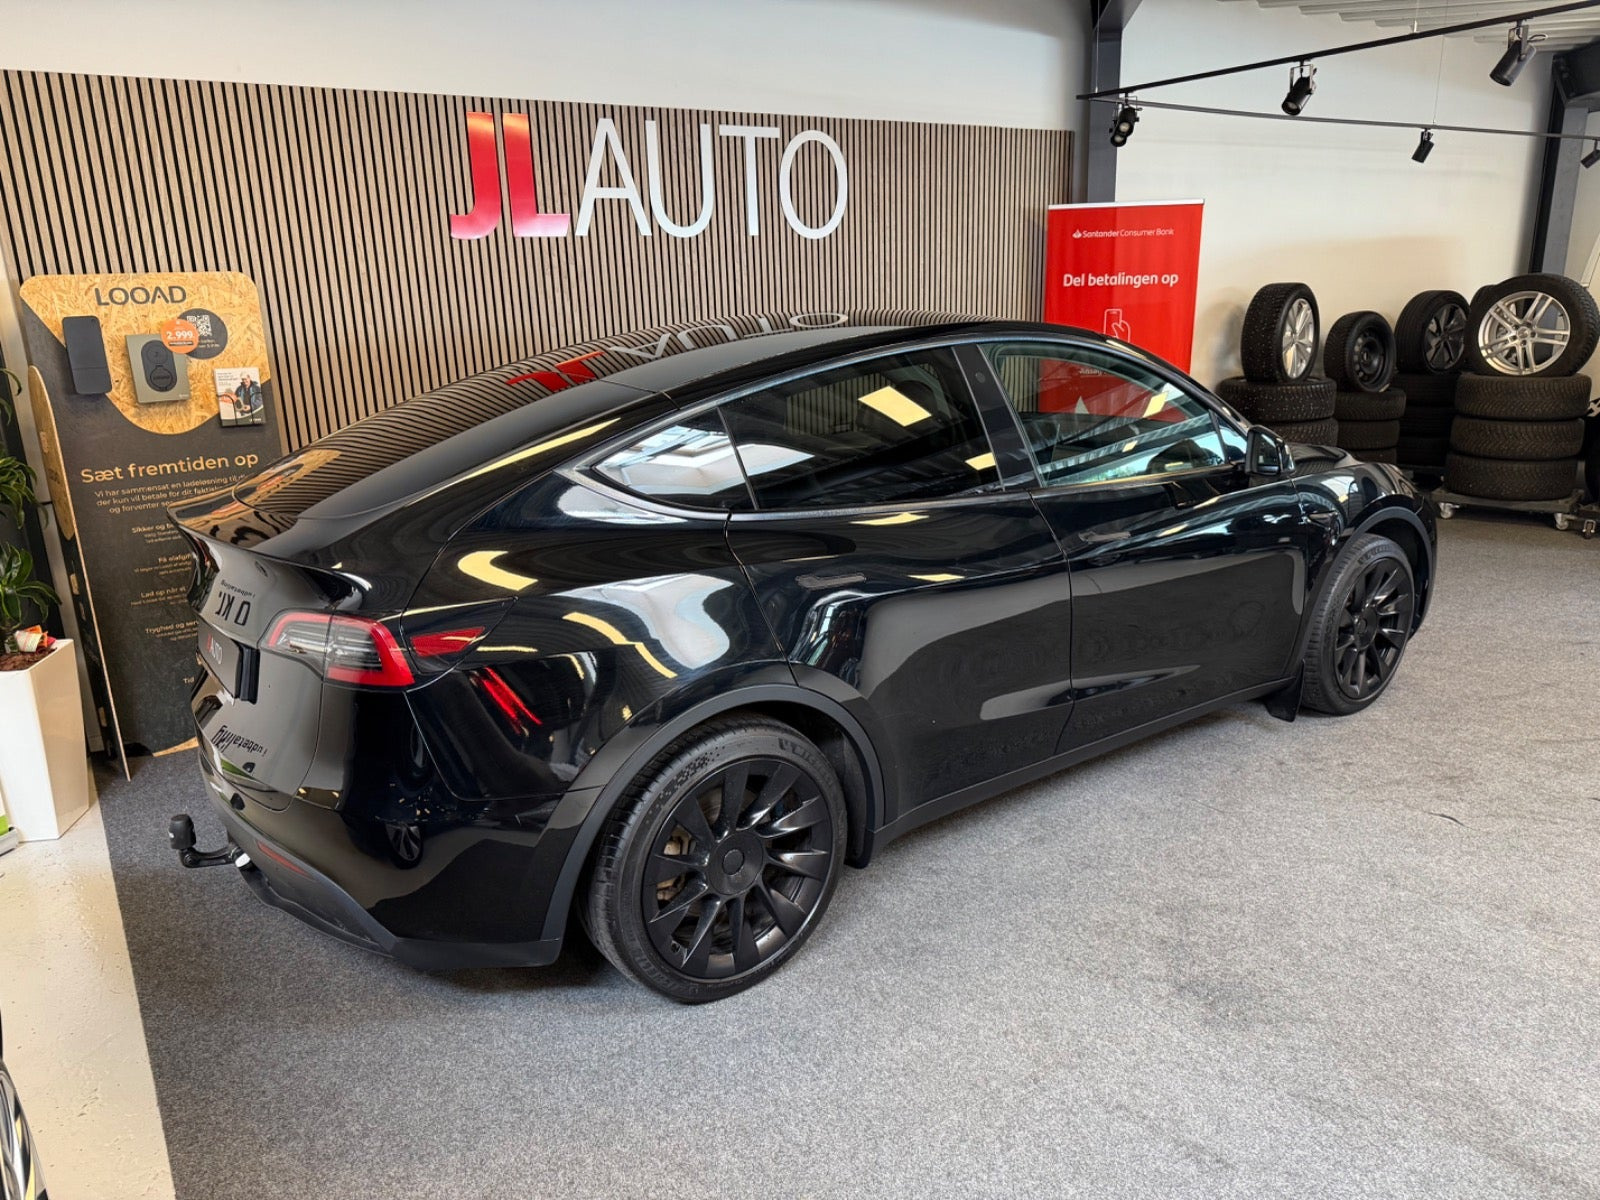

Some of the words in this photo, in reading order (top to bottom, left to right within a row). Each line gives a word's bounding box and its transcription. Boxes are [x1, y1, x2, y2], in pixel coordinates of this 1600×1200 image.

[450, 111, 570, 239] JL
[575, 117, 848, 239] AUTO
[1082, 230, 1119, 239] Santander
[1120, 228, 1155, 237] Consumer
[1156, 227, 1175, 236] Bank
[1063, 273, 1085, 287] Del
[1088, 271, 1158, 289] betalingen
[1161, 273, 1179, 287] op
[94, 285, 187, 306] LOOAD
[81, 467, 124, 484] Sæt
[127, 455, 230, 479] fremtiden
[234, 453, 259, 469] op
[105, 489, 119, 497] har
[121, 483, 170, 495] sammensat
[112, 497, 130, 505] kun
[142, 491, 168, 501] betale
[109, 507, 121, 515] og
[122, 502, 160, 513] forventer
[155, 524, 166, 532] og
